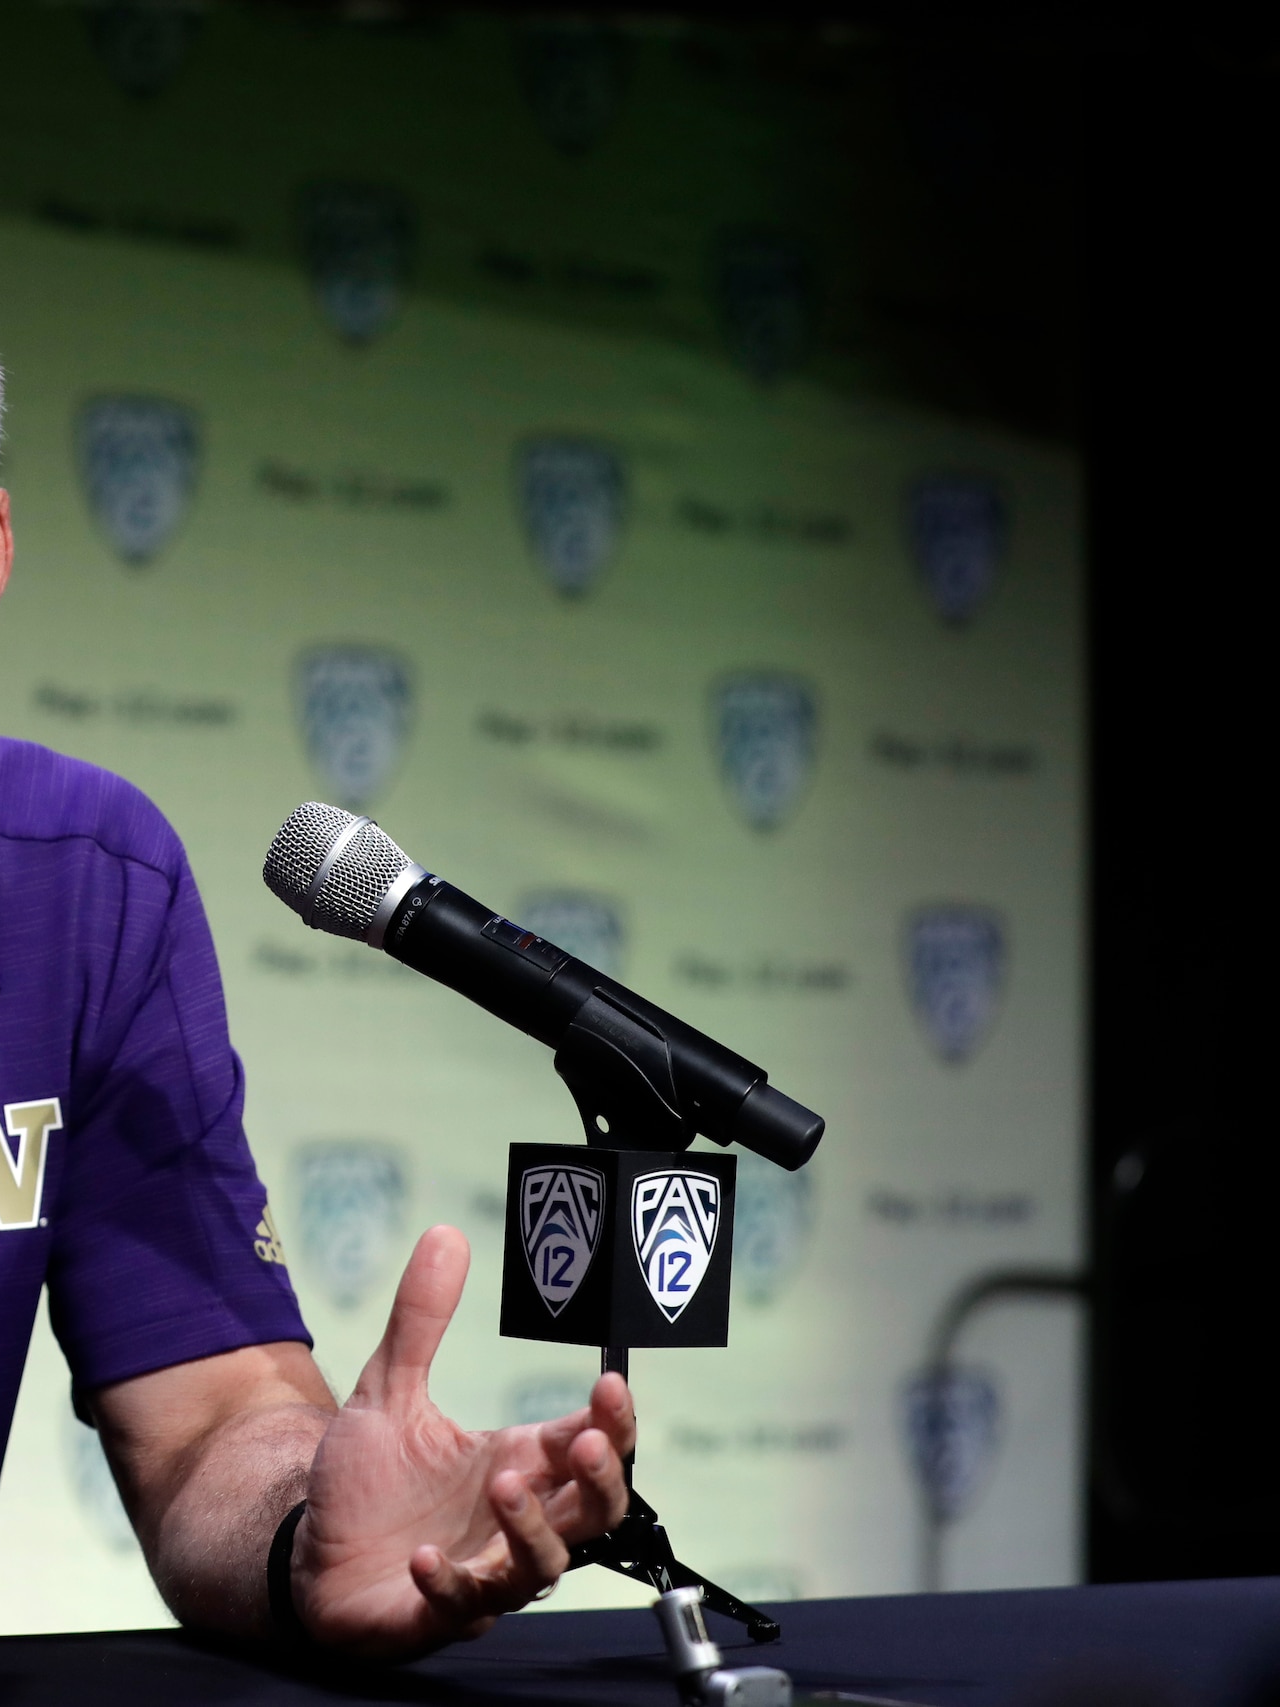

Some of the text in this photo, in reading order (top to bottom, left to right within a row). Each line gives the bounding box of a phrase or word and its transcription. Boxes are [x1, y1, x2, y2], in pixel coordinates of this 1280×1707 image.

[523, 1171, 600, 1248] PAC
[636, 1176, 717, 1255] PAC
[542, 1245, 575, 1288] 12
[657, 1250, 692, 1292] 12
